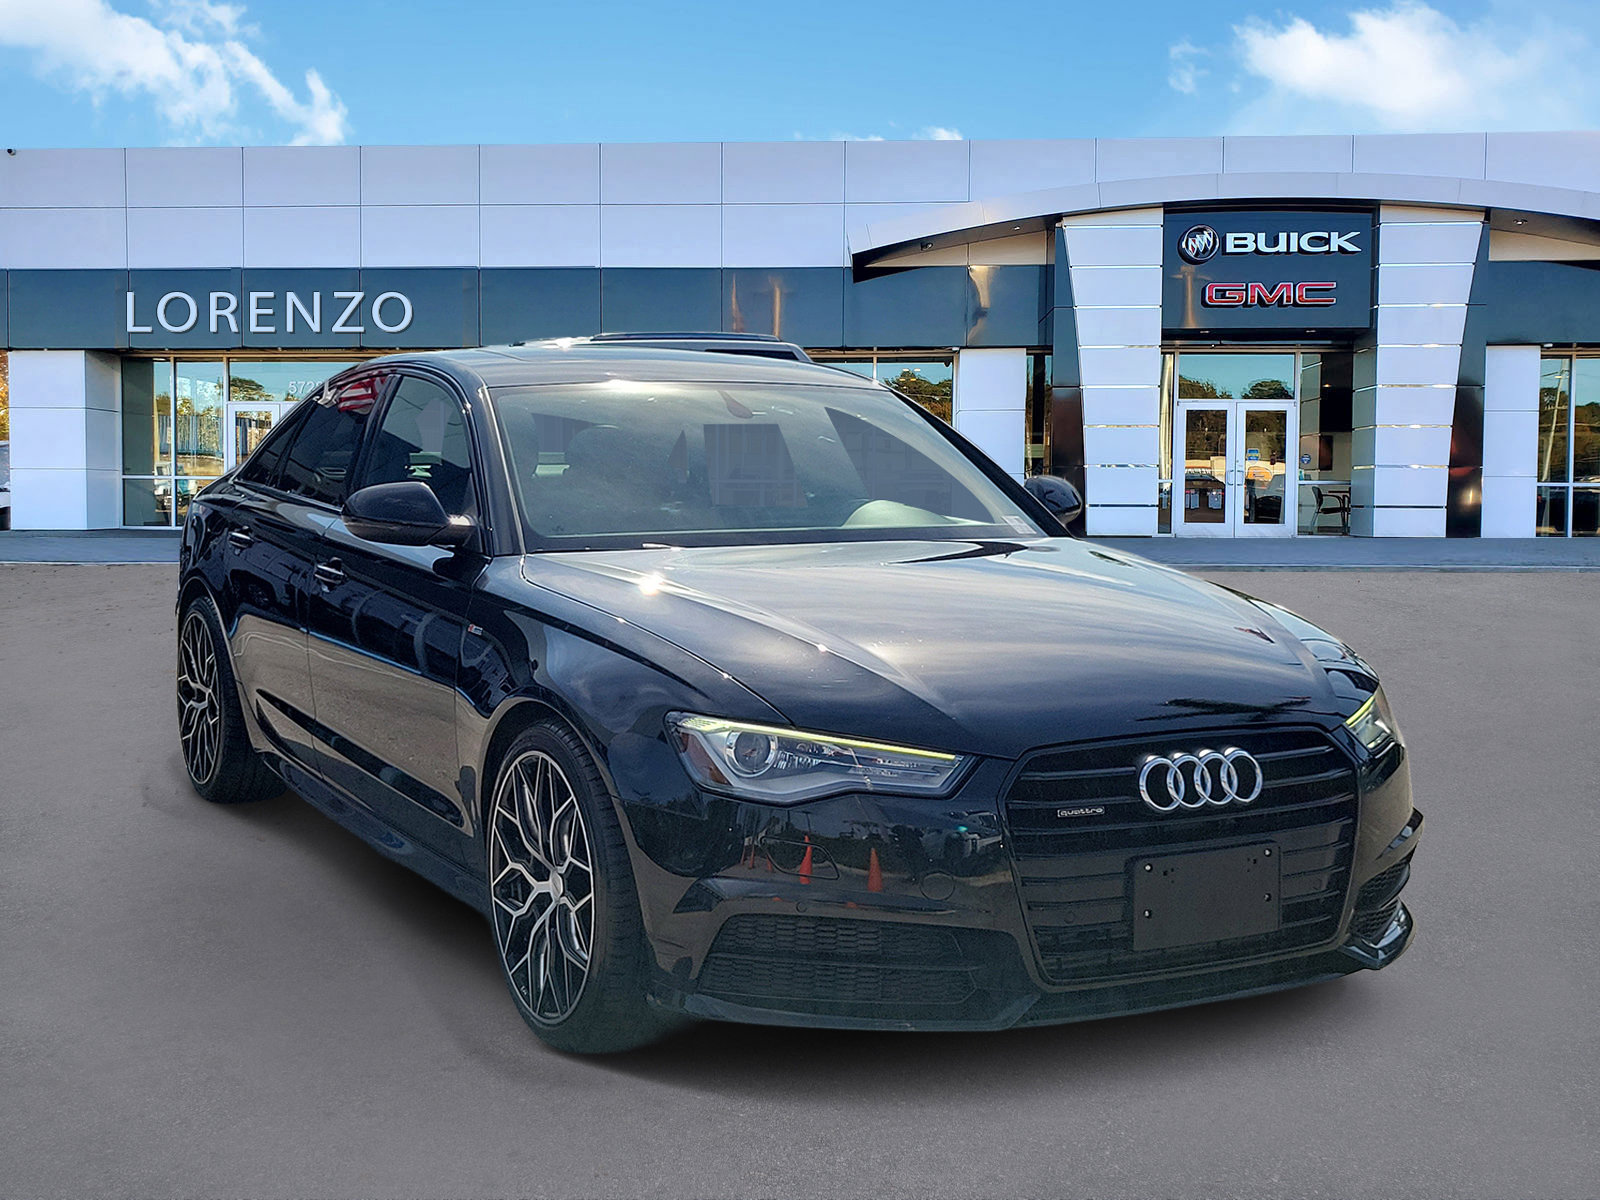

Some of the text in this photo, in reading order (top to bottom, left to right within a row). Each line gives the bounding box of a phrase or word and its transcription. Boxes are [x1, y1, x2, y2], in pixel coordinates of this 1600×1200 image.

[1226, 231, 1361, 253] BUICK
[1205, 281, 1337, 306] GMC
[126, 291, 413, 334] LORENZO
[1060, 807, 1104, 817] quattro
